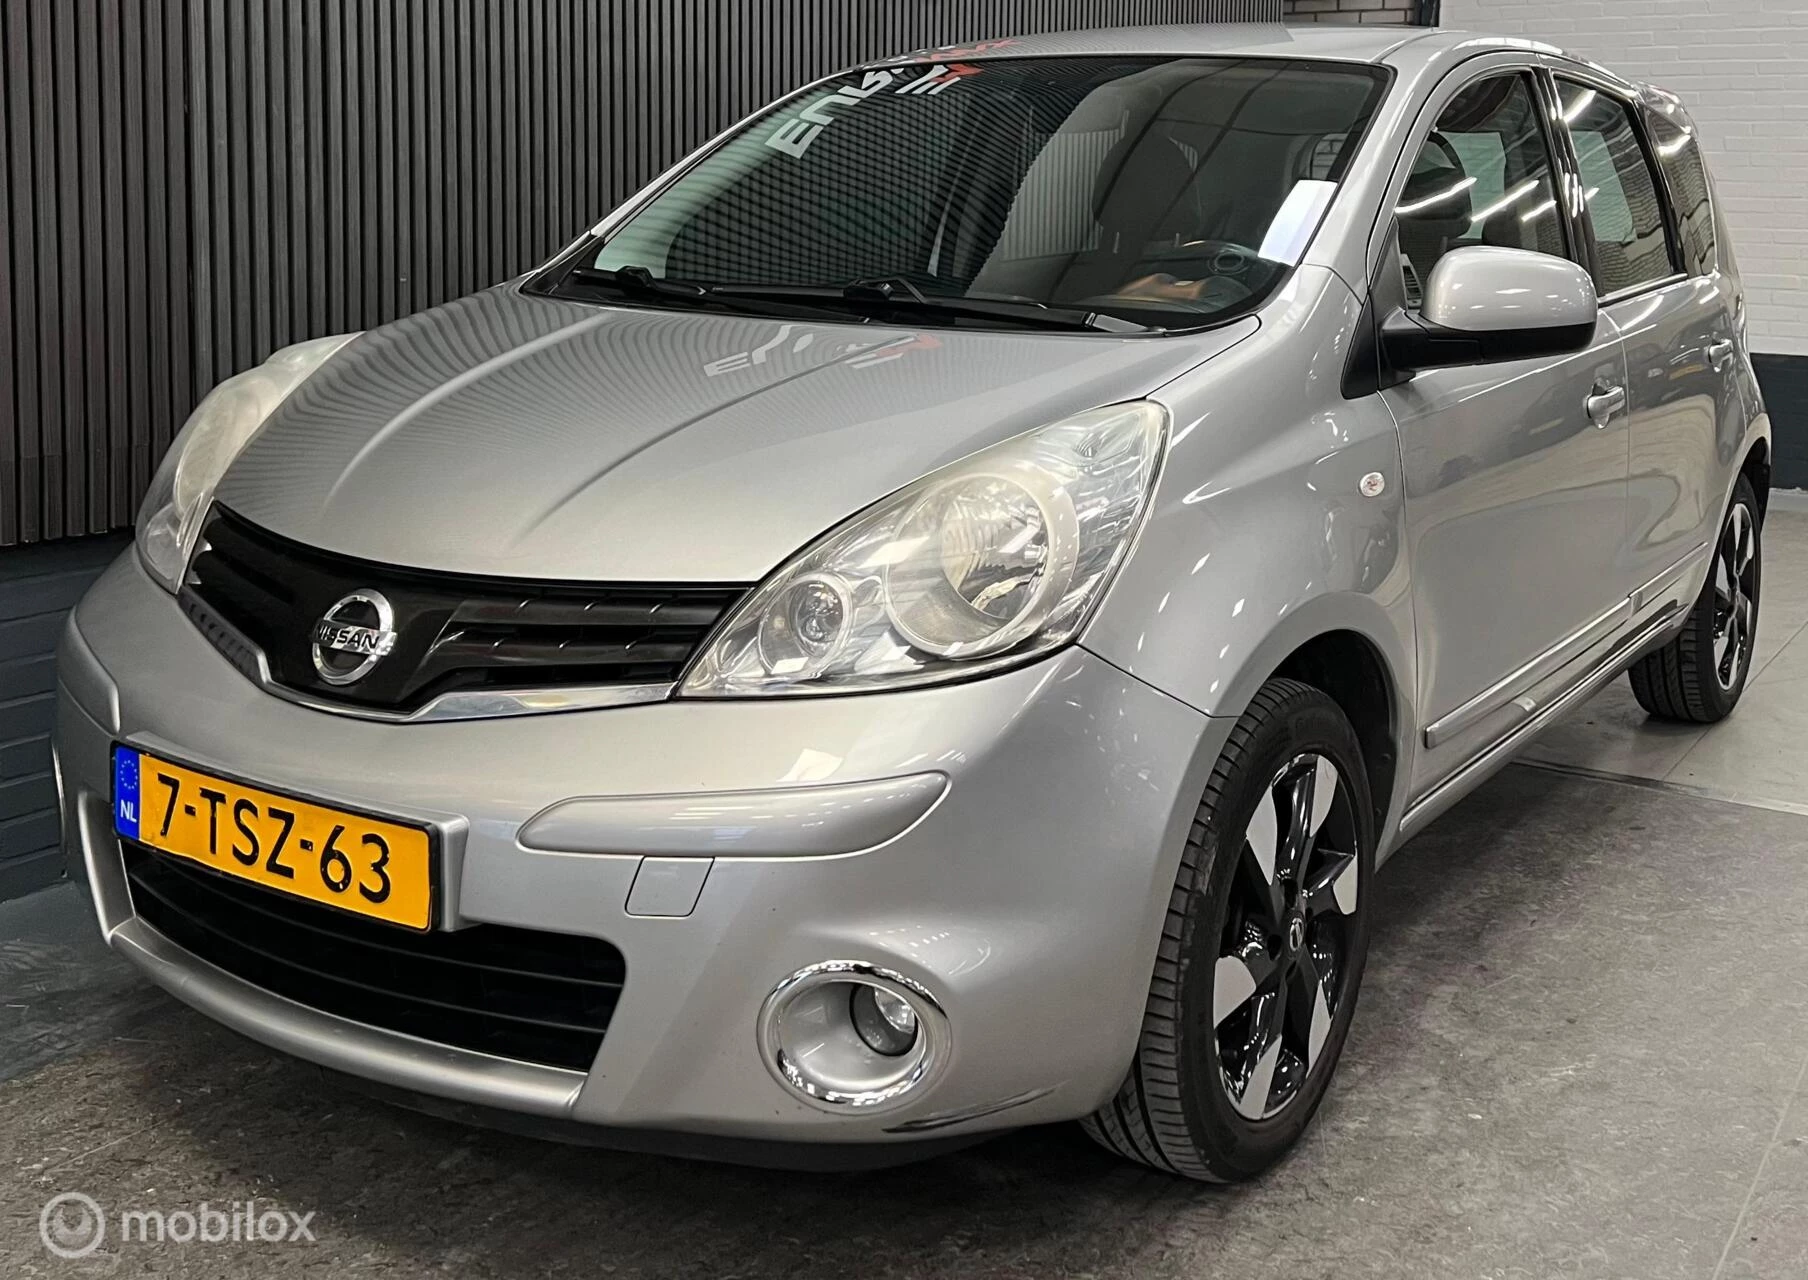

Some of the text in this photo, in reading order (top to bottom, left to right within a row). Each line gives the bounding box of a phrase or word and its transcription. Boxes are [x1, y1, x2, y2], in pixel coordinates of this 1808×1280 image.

[316, 624, 380, 649] NISSAN
[120, 799, 137, 823] NL
[157, 772, 392, 904] 7-TSZ-63
